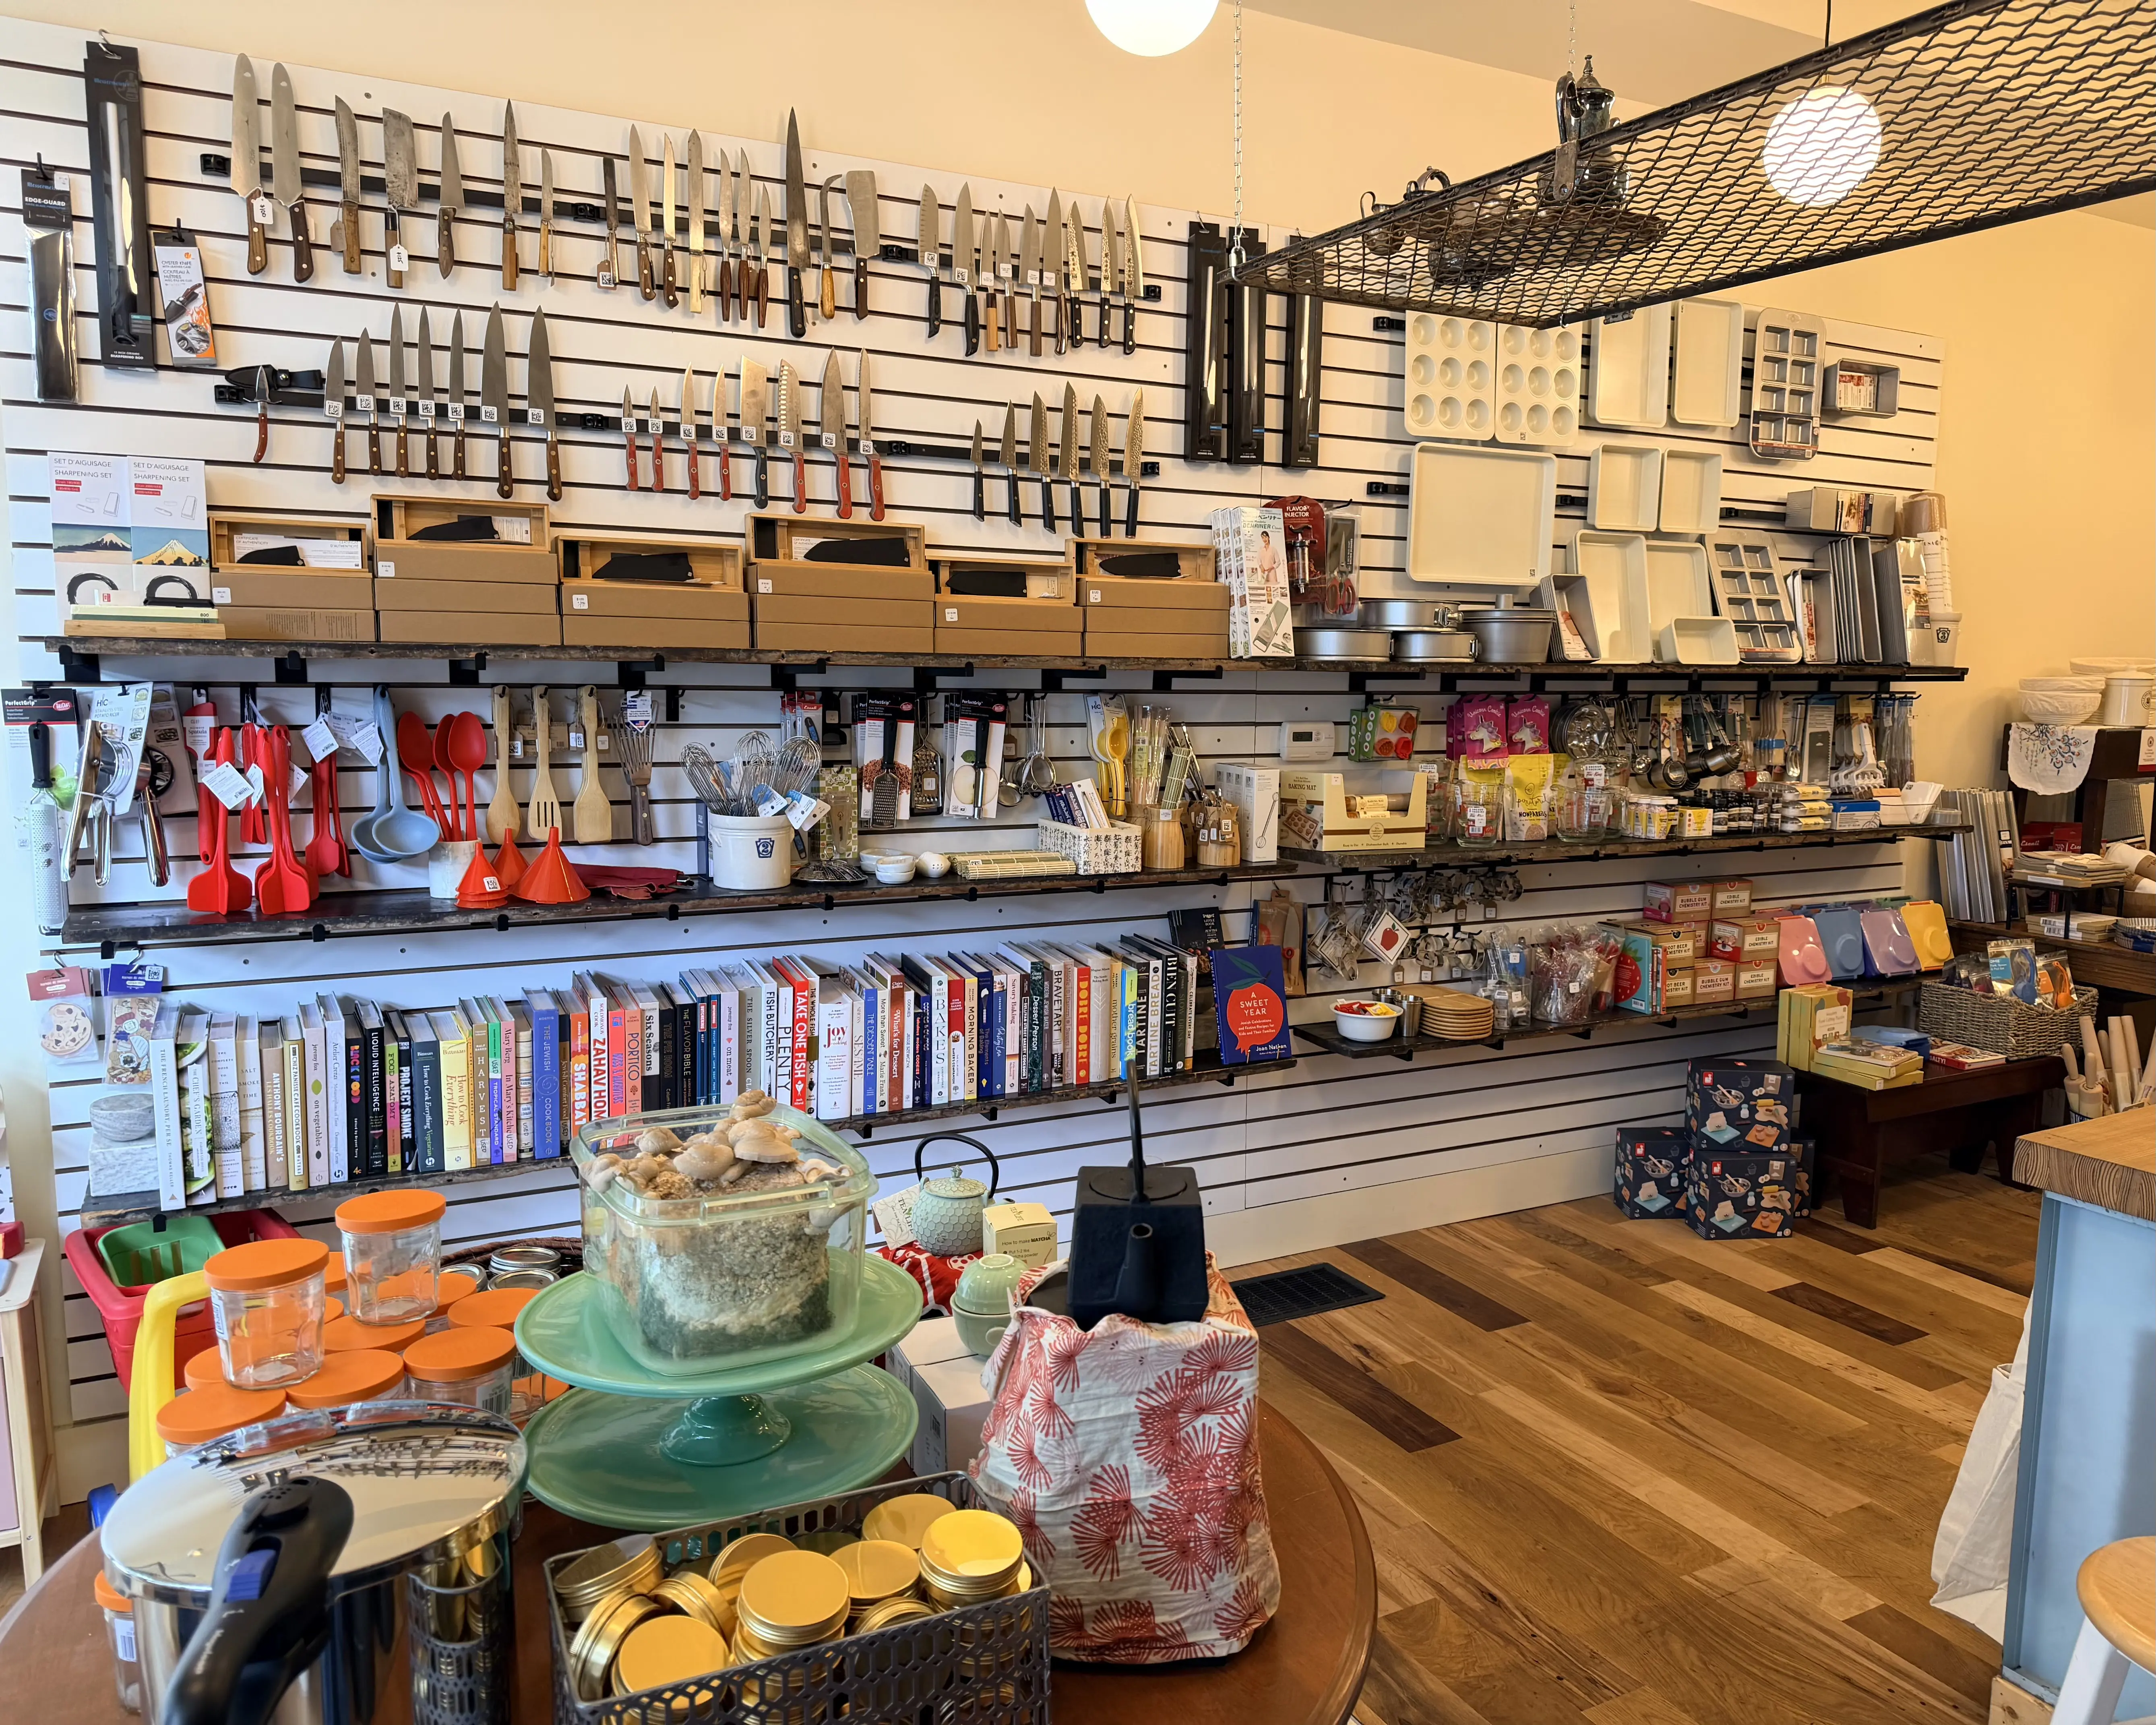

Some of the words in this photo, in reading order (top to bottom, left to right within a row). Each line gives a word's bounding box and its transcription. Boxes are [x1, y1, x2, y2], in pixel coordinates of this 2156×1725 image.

[25, 197, 66, 207] EDGE-GUARD
[54, 469, 98, 478] SHARPENING
[68, 459, 112, 467] D'AIGUISAGE
[147, 463, 189, 472] D'AIGUISAGE
[134, 473, 177, 482] SHARPENING
[1941, 631, 1946, 639] 3
[1467, 709, 1486, 718] Unicorn
[1511, 707, 1531, 718] Unicorn
[761, 843, 768, 854] 2
[1166, 957, 1177, 989] BIEN
[766, 991, 775, 1011] FISH
[796, 990, 808, 1019] TAKE
[1054, 970, 1062, 1032] BRAVETART
[1078, 981, 1088, 1021] DOBRE
[1151, 974, 1160, 1016] BREAD
[1240, 999, 1268, 1008] SWEET
[645, 1015, 653, 1028] Six
[1127, 1003, 1135, 1030] bread
[1165, 993, 1176, 1026] CUIT
[765, 1014, 775, 1062] BUTCHERY
[795, 1022, 807, 1049] ONE
[824, 1024, 848, 1048] joy
[1136, 996, 1147, 1055] TARTINE
[628, 1032, 639, 1081] PORTICO
[727, 1047, 732, 1057] on
[854, 1035, 863, 1080] SESAME
[1078, 1025, 1088, 1064] DOBRE
[1127, 1032, 1135, 1056] book
[1149, 1021, 1159, 1075] TARTINE
[777, 1026, 792, 1091] PLENTY
[794, 1053, 806, 1078] FISH
[273, 1073, 281, 1110] ANTHONY
[372, 1061, 380, 1112] INTELLIGENCE
[400, 1067, 411, 1103] PROJECT
[423, 1086, 431, 1101] Cook
[457, 1074, 467, 1093] How
[314, 1100, 320, 1109] on
[445, 1075, 457, 1127] Everything
[457, 1094, 466, 1104] to
[313, 1111, 321, 1146] vegetables
[401, 1105, 412, 1139] SMOKE
[423, 1102, 432, 1129] Everything
[458, 1104, 467, 1126] Cook
[275, 1112, 284, 1162] BOURDAIN'S
